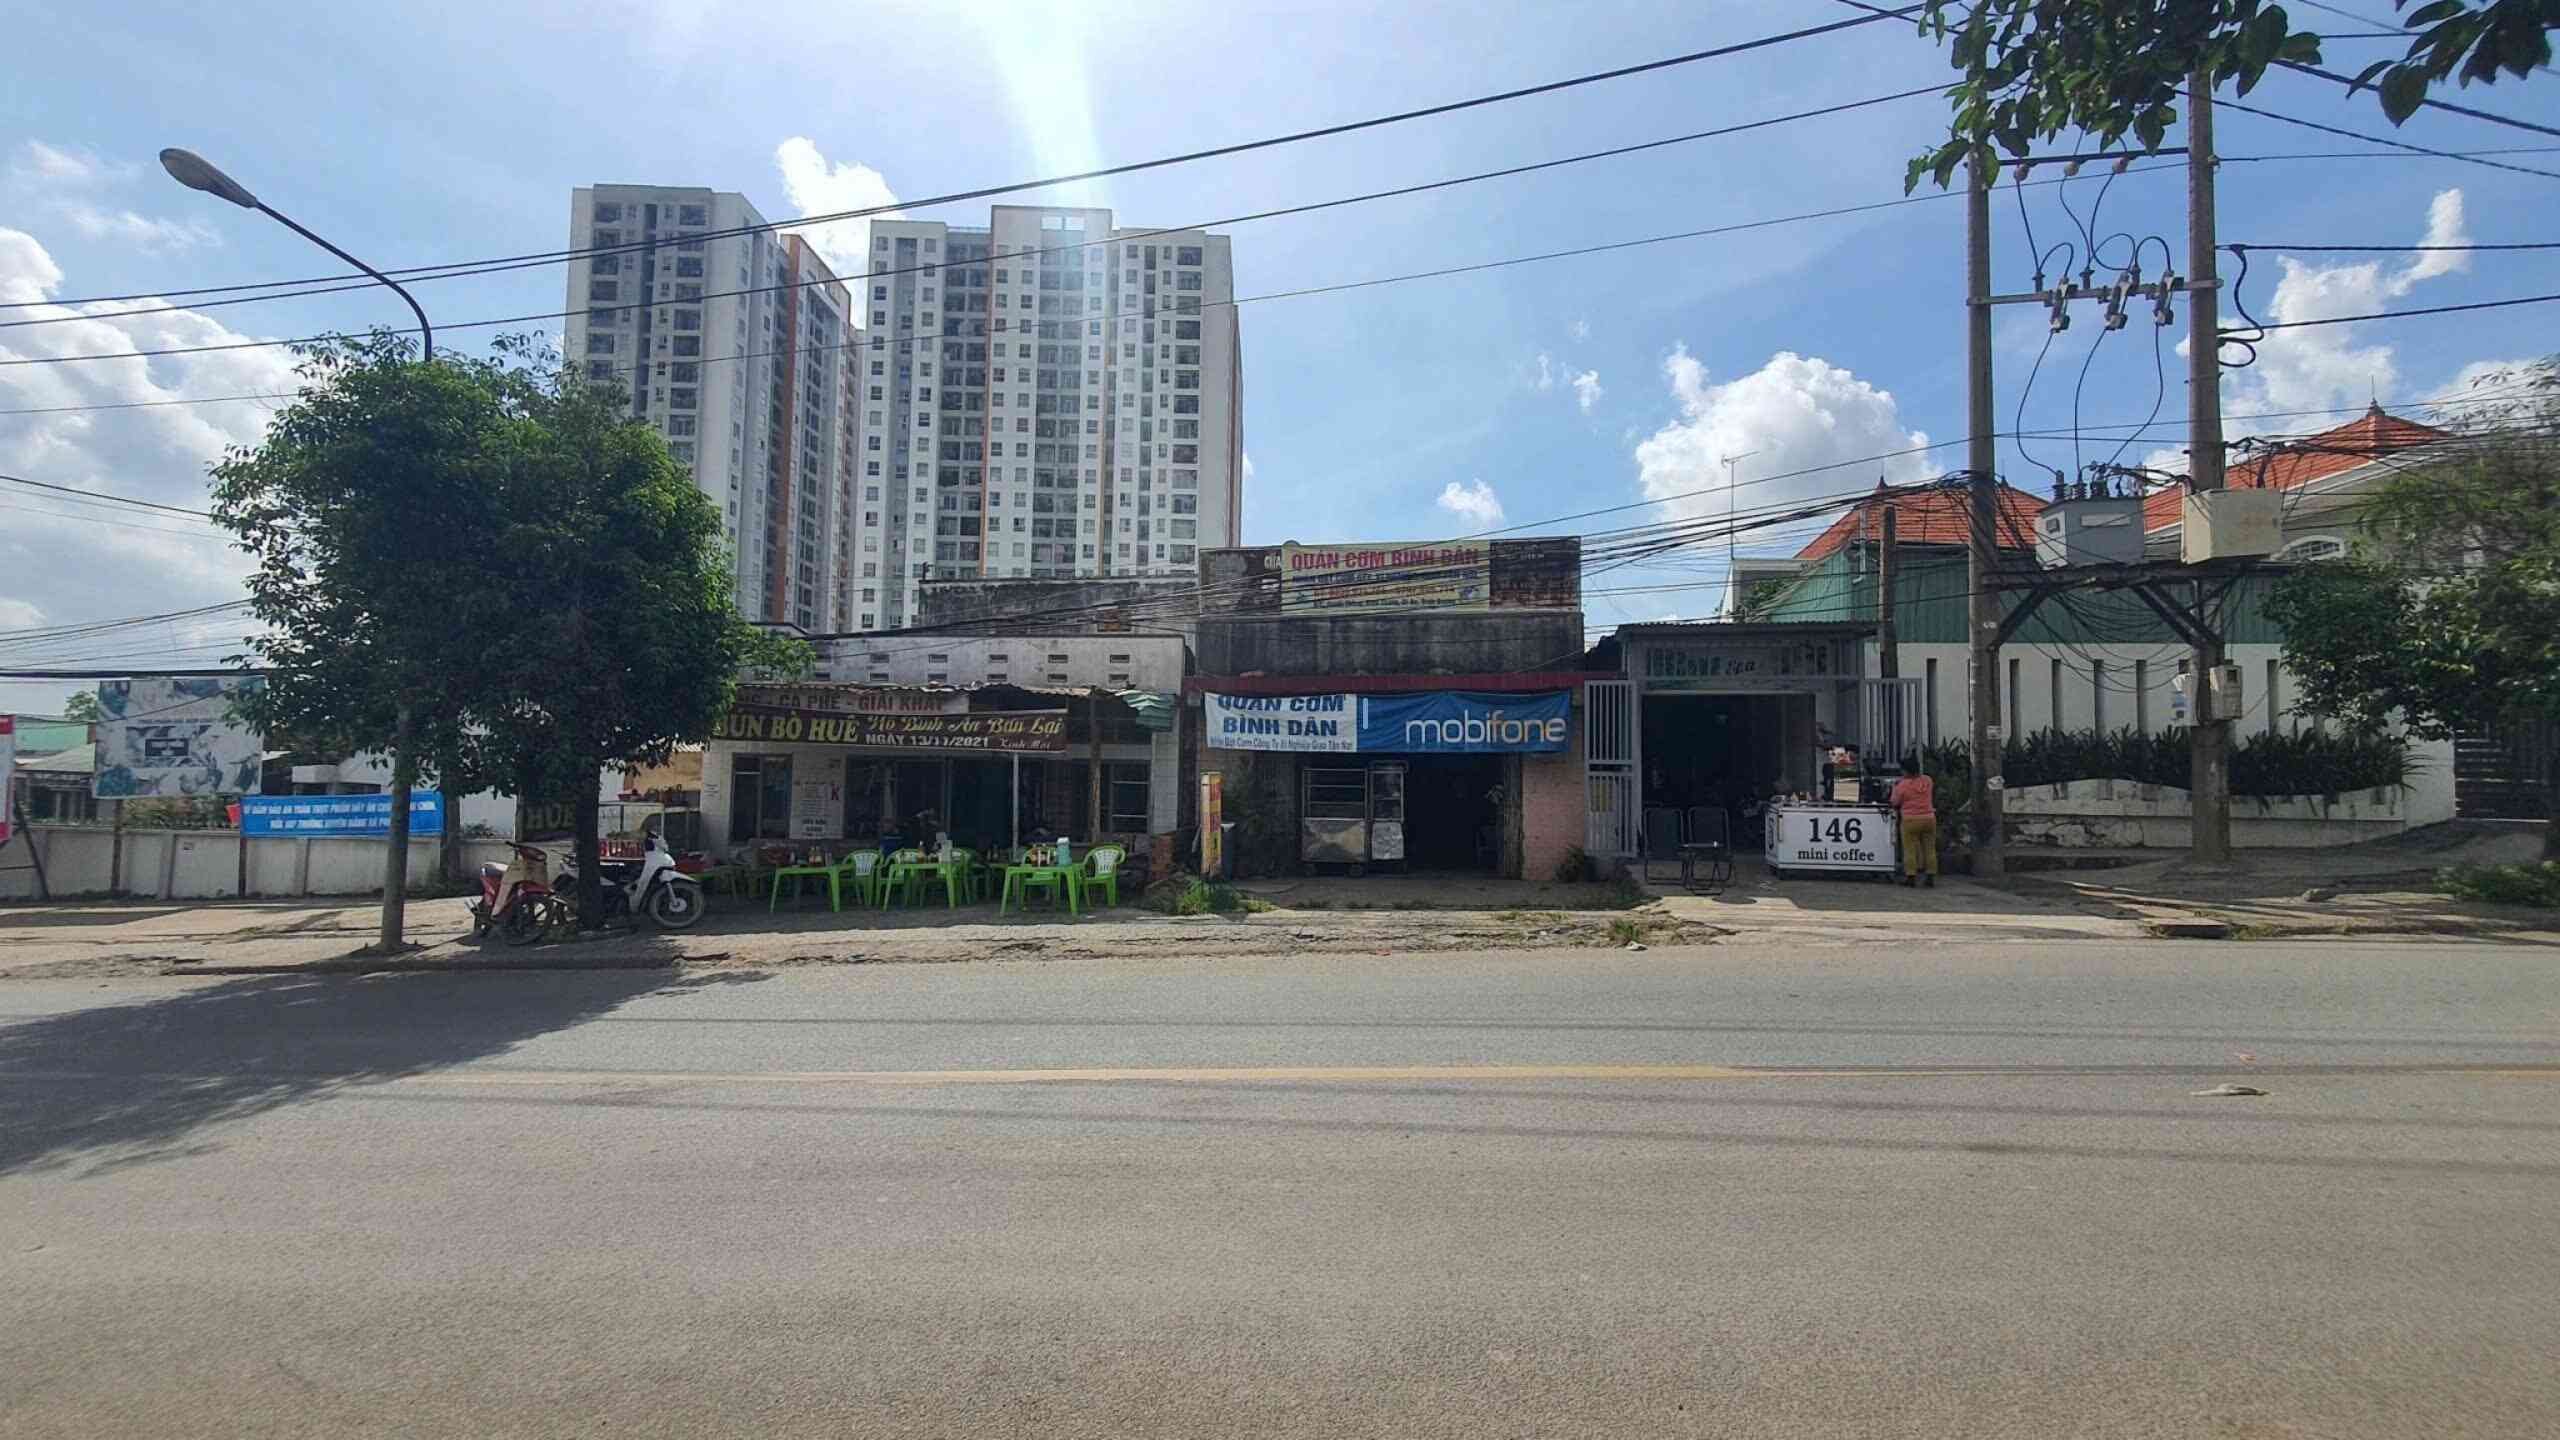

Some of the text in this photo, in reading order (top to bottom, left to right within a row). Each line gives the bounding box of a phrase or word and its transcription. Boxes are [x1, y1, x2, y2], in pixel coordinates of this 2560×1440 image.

[1223, 714, 1338, 736] BÌNH DÂN
[1405, 709, 1567, 744] mobifone
[1809, 817, 1863, 844] 146
[1797, 847, 1875, 861] mini coffee
